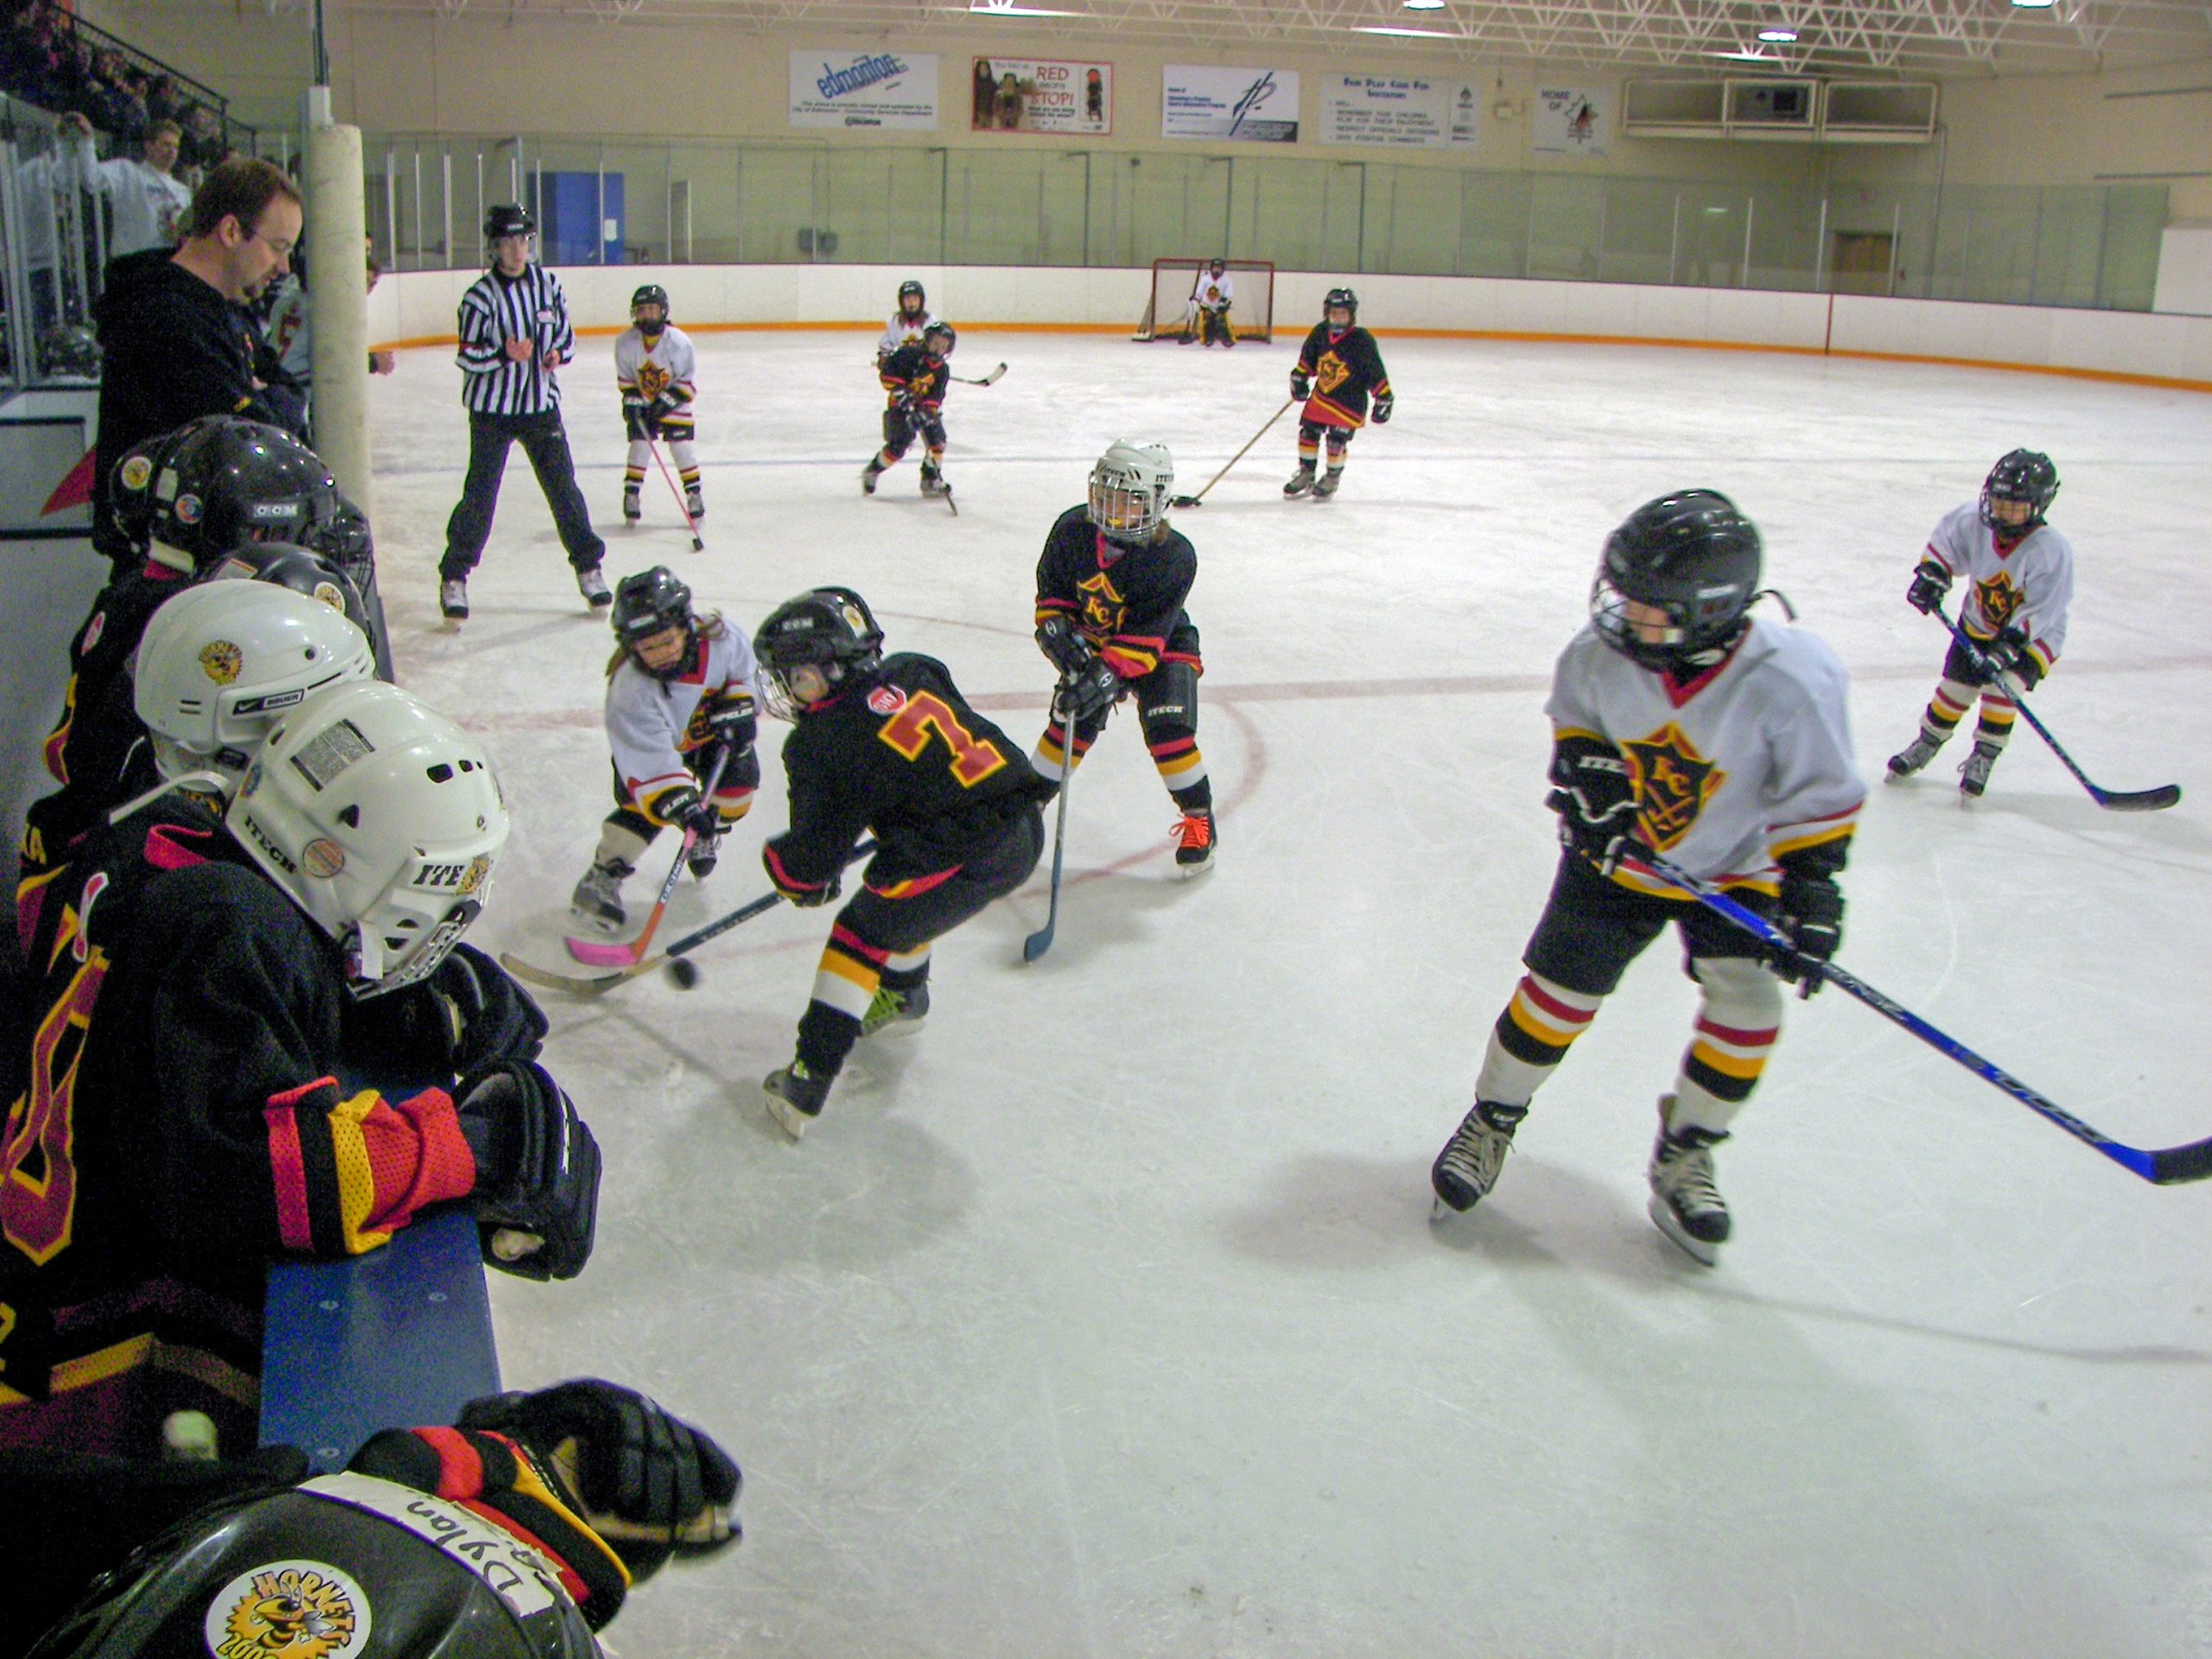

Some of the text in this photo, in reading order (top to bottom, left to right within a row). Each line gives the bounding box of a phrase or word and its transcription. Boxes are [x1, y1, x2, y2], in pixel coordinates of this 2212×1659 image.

[1037, 67, 1069, 80] RED
[1541, 89, 1570, 99] HOME
[1549, 101, 1561, 111] OF
[1147, 705, 1183, 717] ITECH
[877, 690, 1008, 789] 7
[245, 815, 298, 874] ITECH
[412, 864, 465, 886] ITE
[406, 1501, 524, 1592] Dylan
[251, 1568, 356, 1647] HORNETS
[216, 1631, 280, 1659] 200
